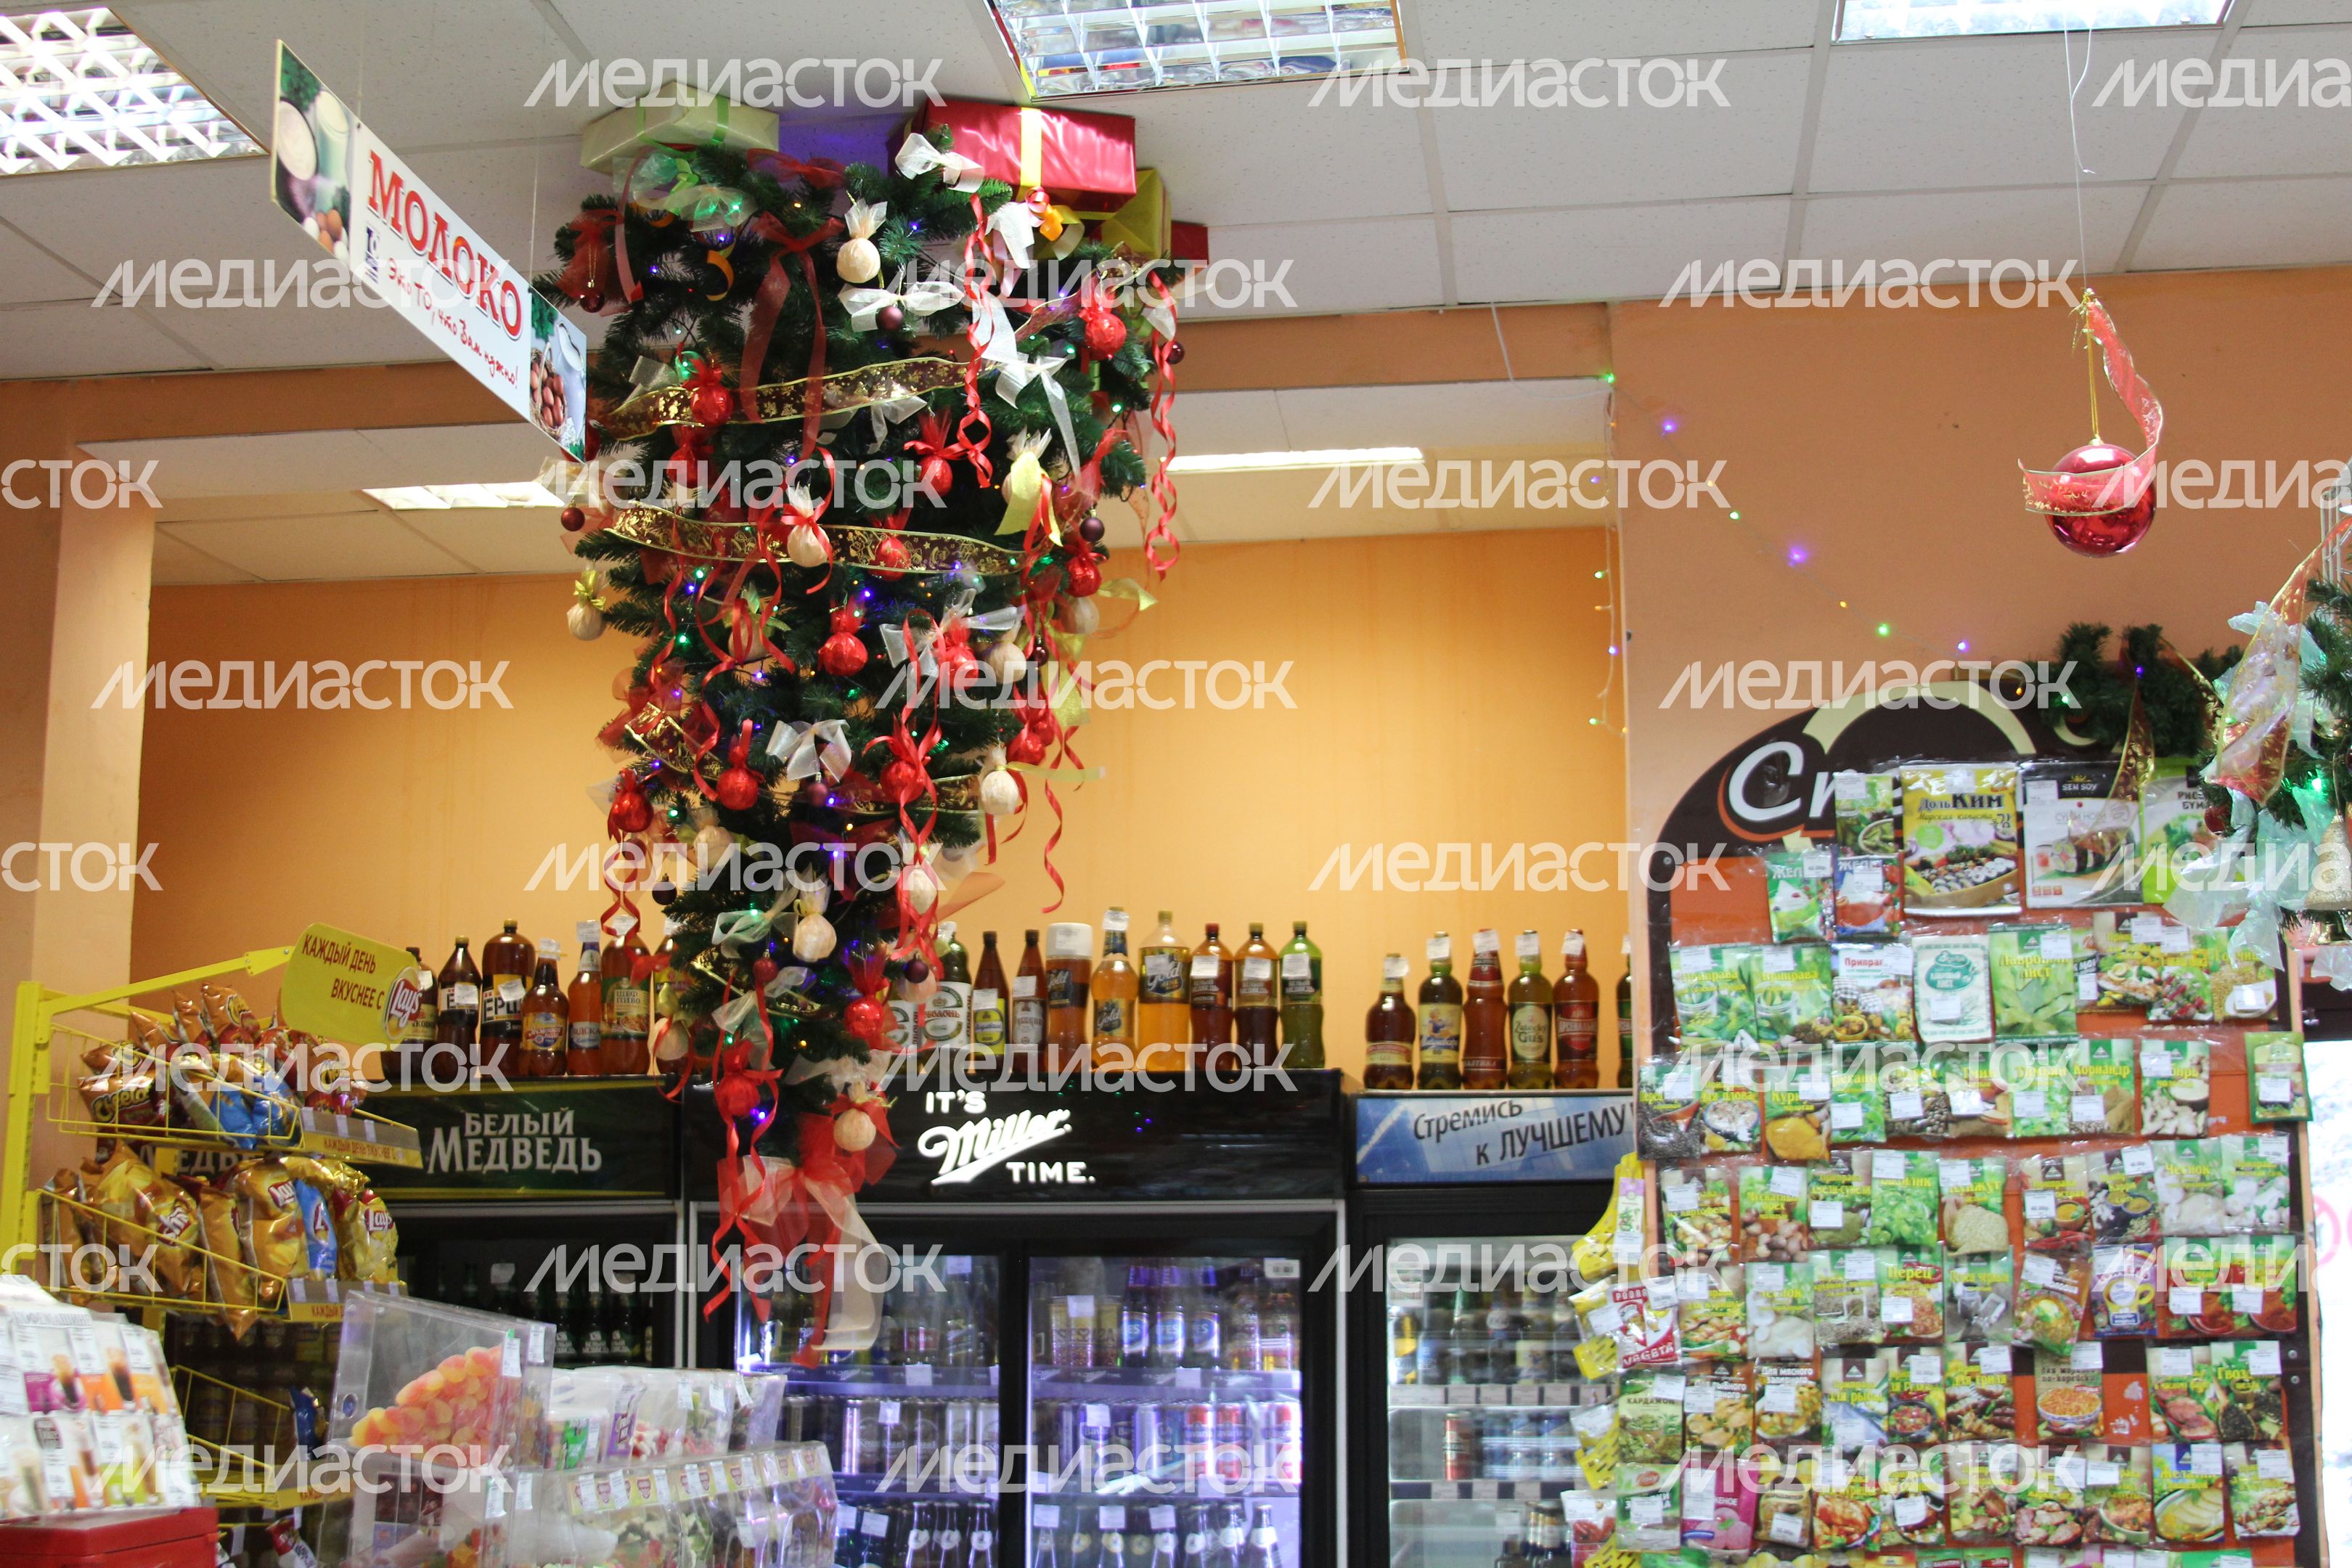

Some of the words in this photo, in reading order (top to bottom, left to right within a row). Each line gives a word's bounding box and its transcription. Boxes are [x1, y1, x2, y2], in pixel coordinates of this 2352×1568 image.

[367, 150, 523, 341] МОЛОКО
[302, 934, 352, 966] КАЖДЫЙ
[349, 949, 376, 974] ДЕНЬ
[331, 978, 377, 1009] ВКУСНЕЕ
[376, 990, 385, 1010] С
[924, 1090, 987, 1114] IT'S
[465, 1107, 576, 1138] БЕЛЫЙ
[1413, 1100, 1524, 1143] Стремись
[917, 1108, 1072, 1185] Miller
[1887, 1265, 1932, 1281] Перец
